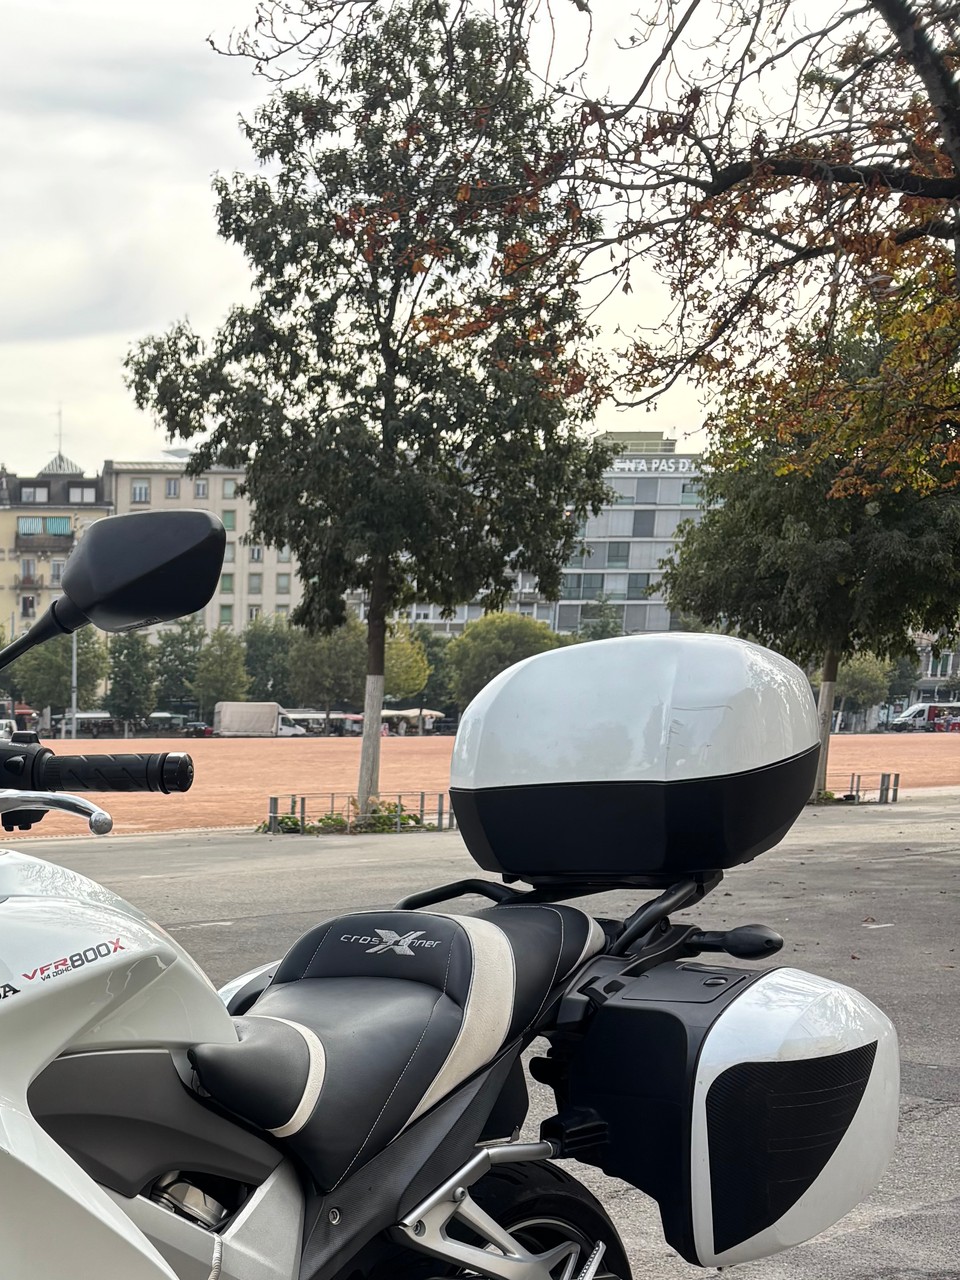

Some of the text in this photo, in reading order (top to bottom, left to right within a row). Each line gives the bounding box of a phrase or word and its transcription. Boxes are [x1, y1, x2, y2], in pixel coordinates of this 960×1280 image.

[651, 459, 676, 473] PAS
[22, 938, 125, 981] VFR800X
[41, 965, 73, 982] V4 DOHC
